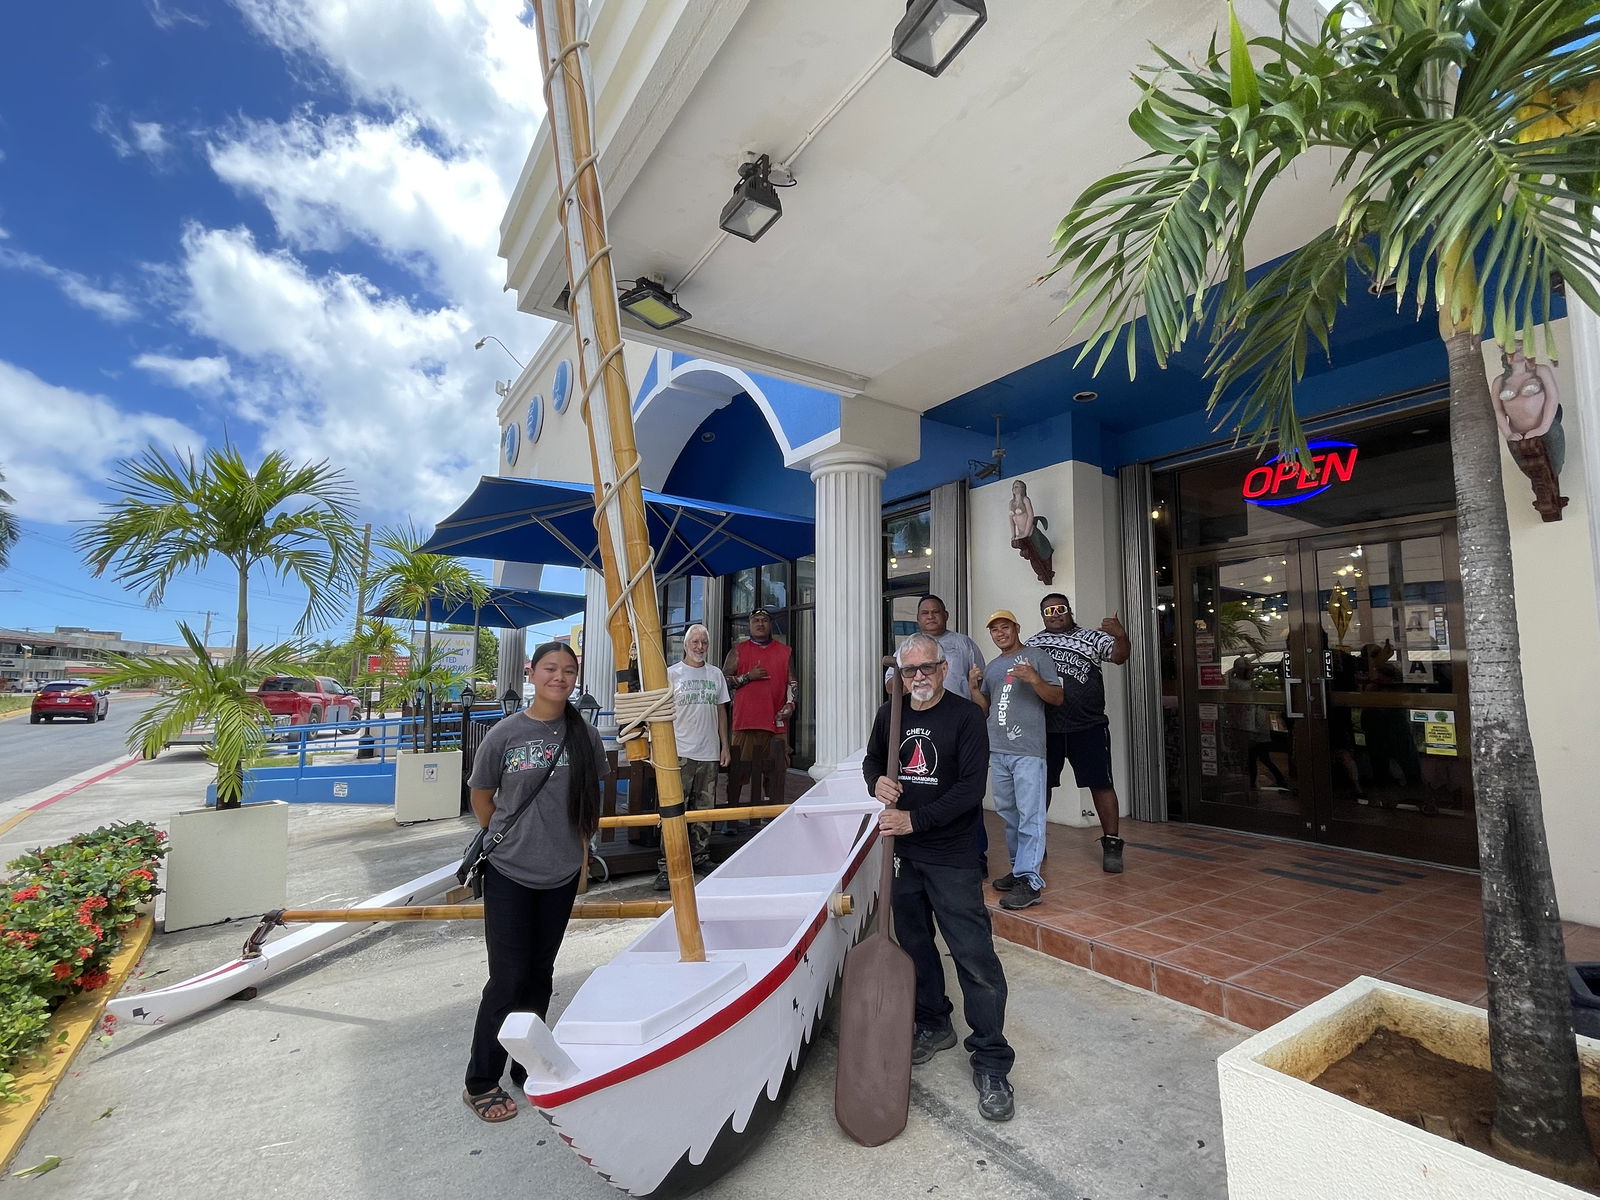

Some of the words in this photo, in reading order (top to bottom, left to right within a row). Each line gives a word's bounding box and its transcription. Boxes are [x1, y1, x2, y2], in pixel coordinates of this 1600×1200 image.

[1242, 448, 1358, 498] OPEN
[906, 727, 931, 736] CHE'LU
[911, 775, 938, 783] CHAMORRO
